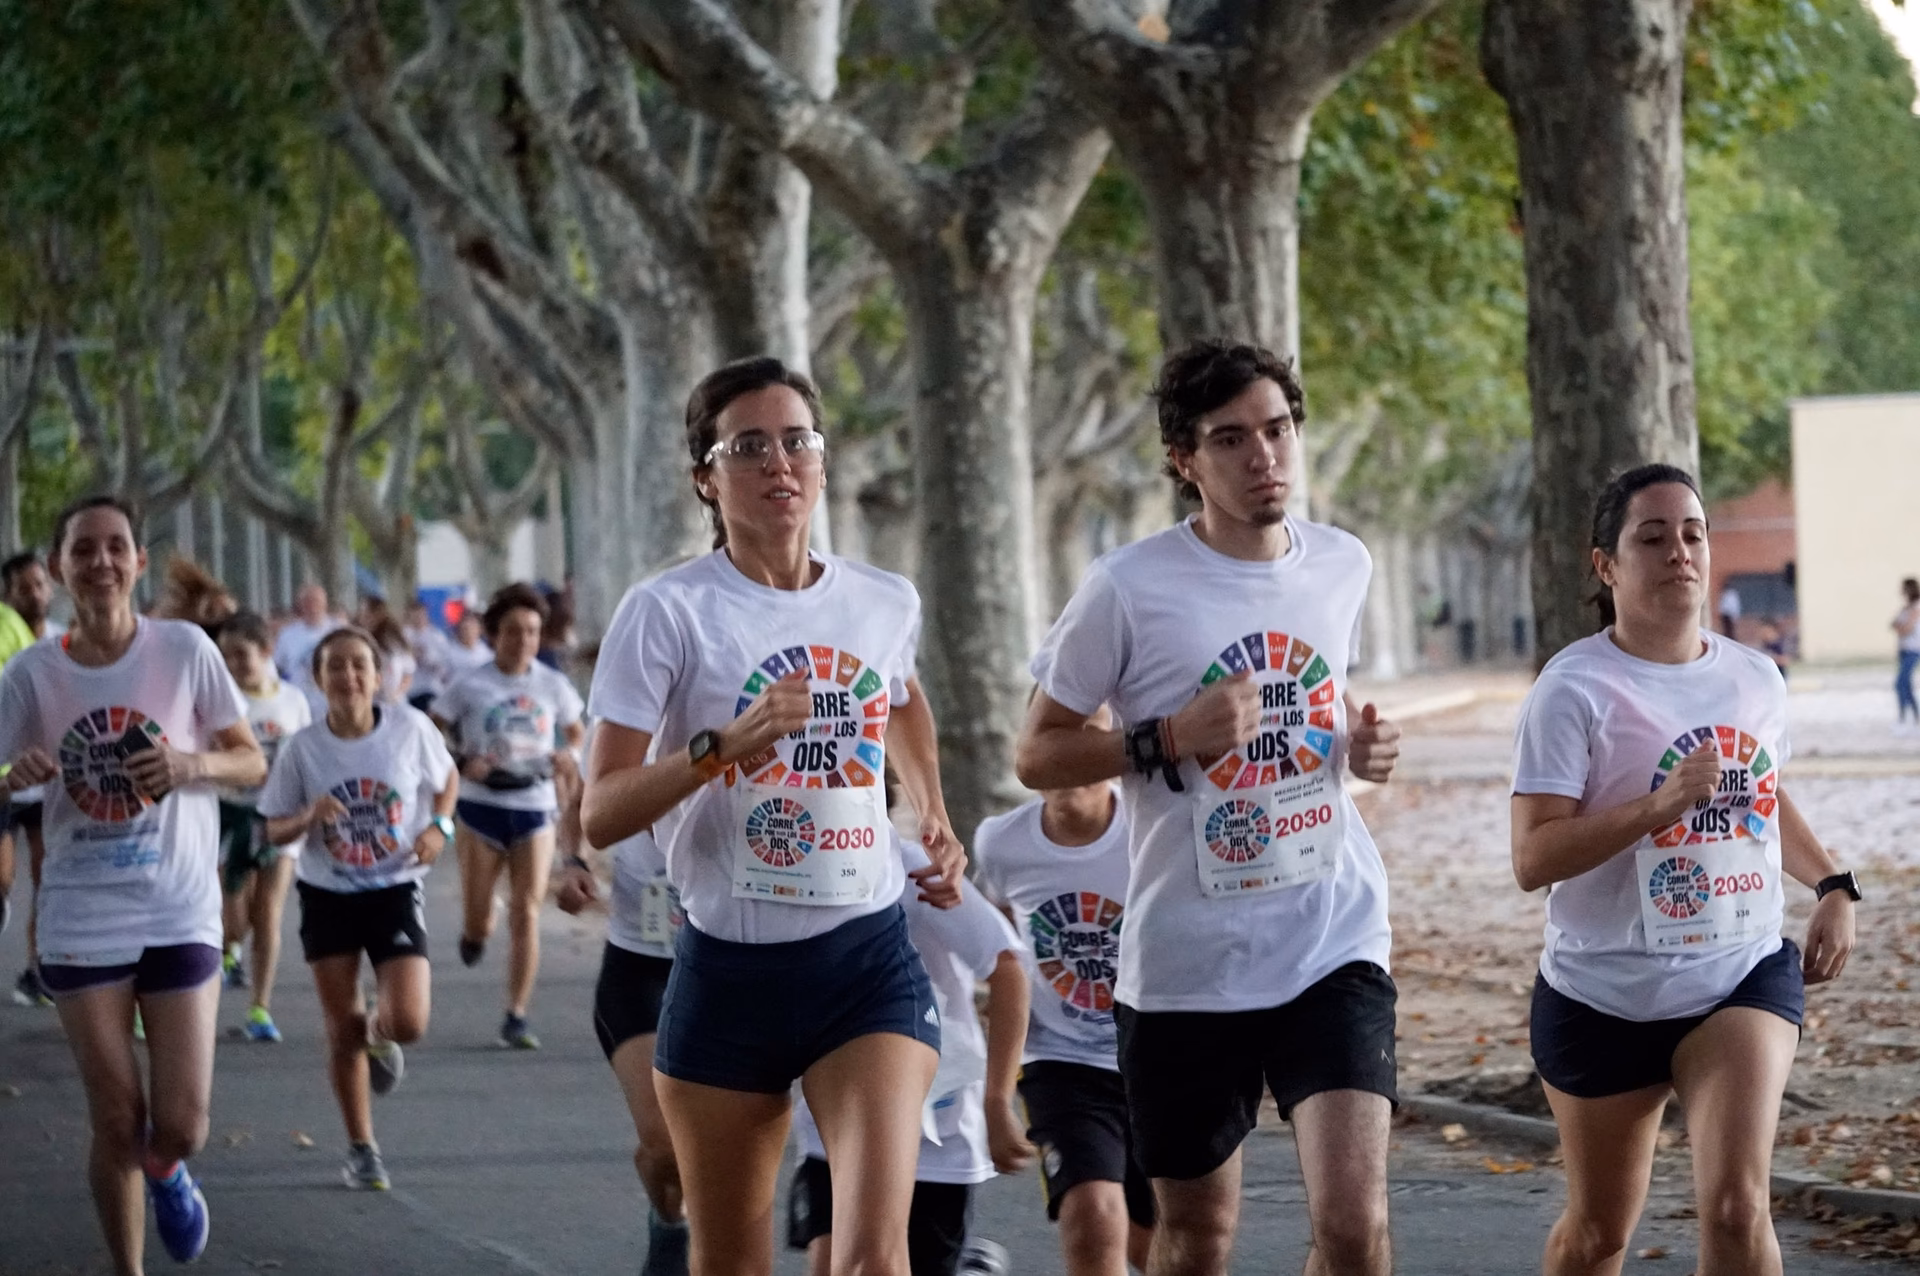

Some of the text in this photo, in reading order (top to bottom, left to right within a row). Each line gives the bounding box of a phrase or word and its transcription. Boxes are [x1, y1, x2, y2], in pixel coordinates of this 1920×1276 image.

[812, 690, 851, 718] RRE
[1262, 681, 1297, 709] RRE
[1283, 709, 1304, 727] LOS
[834, 720, 857, 738] LOS
[1247, 730, 1290, 762] ODS
[792, 740, 838, 773] ODS
[1717, 768, 1748, 793] RRE
[1730, 794, 1752, 808] LOS
[767, 817, 795, 830] CORRE
[1224, 817, 1250, 829] CORRE
[1275, 803, 1333, 839] 2030
[1691, 808, 1731, 833] ODS
[770, 838, 790, 851] ODS
[818, 826, 875, 851] 2030
[1229, 835, 1249, 848] ODS
[840, 868, 857, 878] 350
[1666, 873, 1691, 885] CORRE
[1713, 872, 1764, 898] 2030
[1671, 892, 1690, 905] ODS
[1075, 958, 1117, 981] ODS
